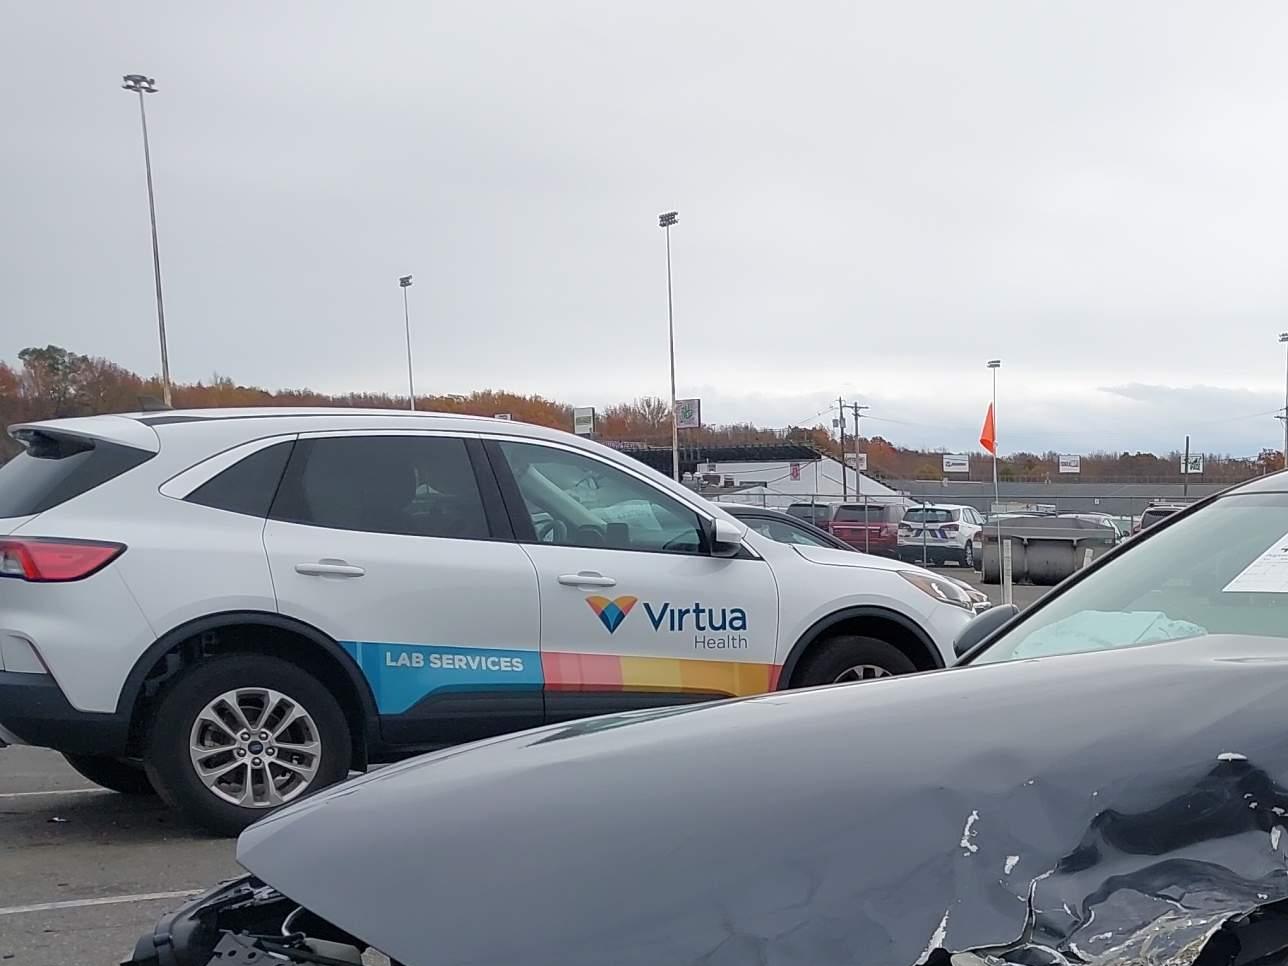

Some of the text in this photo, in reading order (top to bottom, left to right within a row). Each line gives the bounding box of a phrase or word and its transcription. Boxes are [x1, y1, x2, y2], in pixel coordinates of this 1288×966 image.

[643, 602, 748, 632] Virtua
[694, 634, 748, 649] Health
[385, 652, 524, 672] LAB SERVICES
